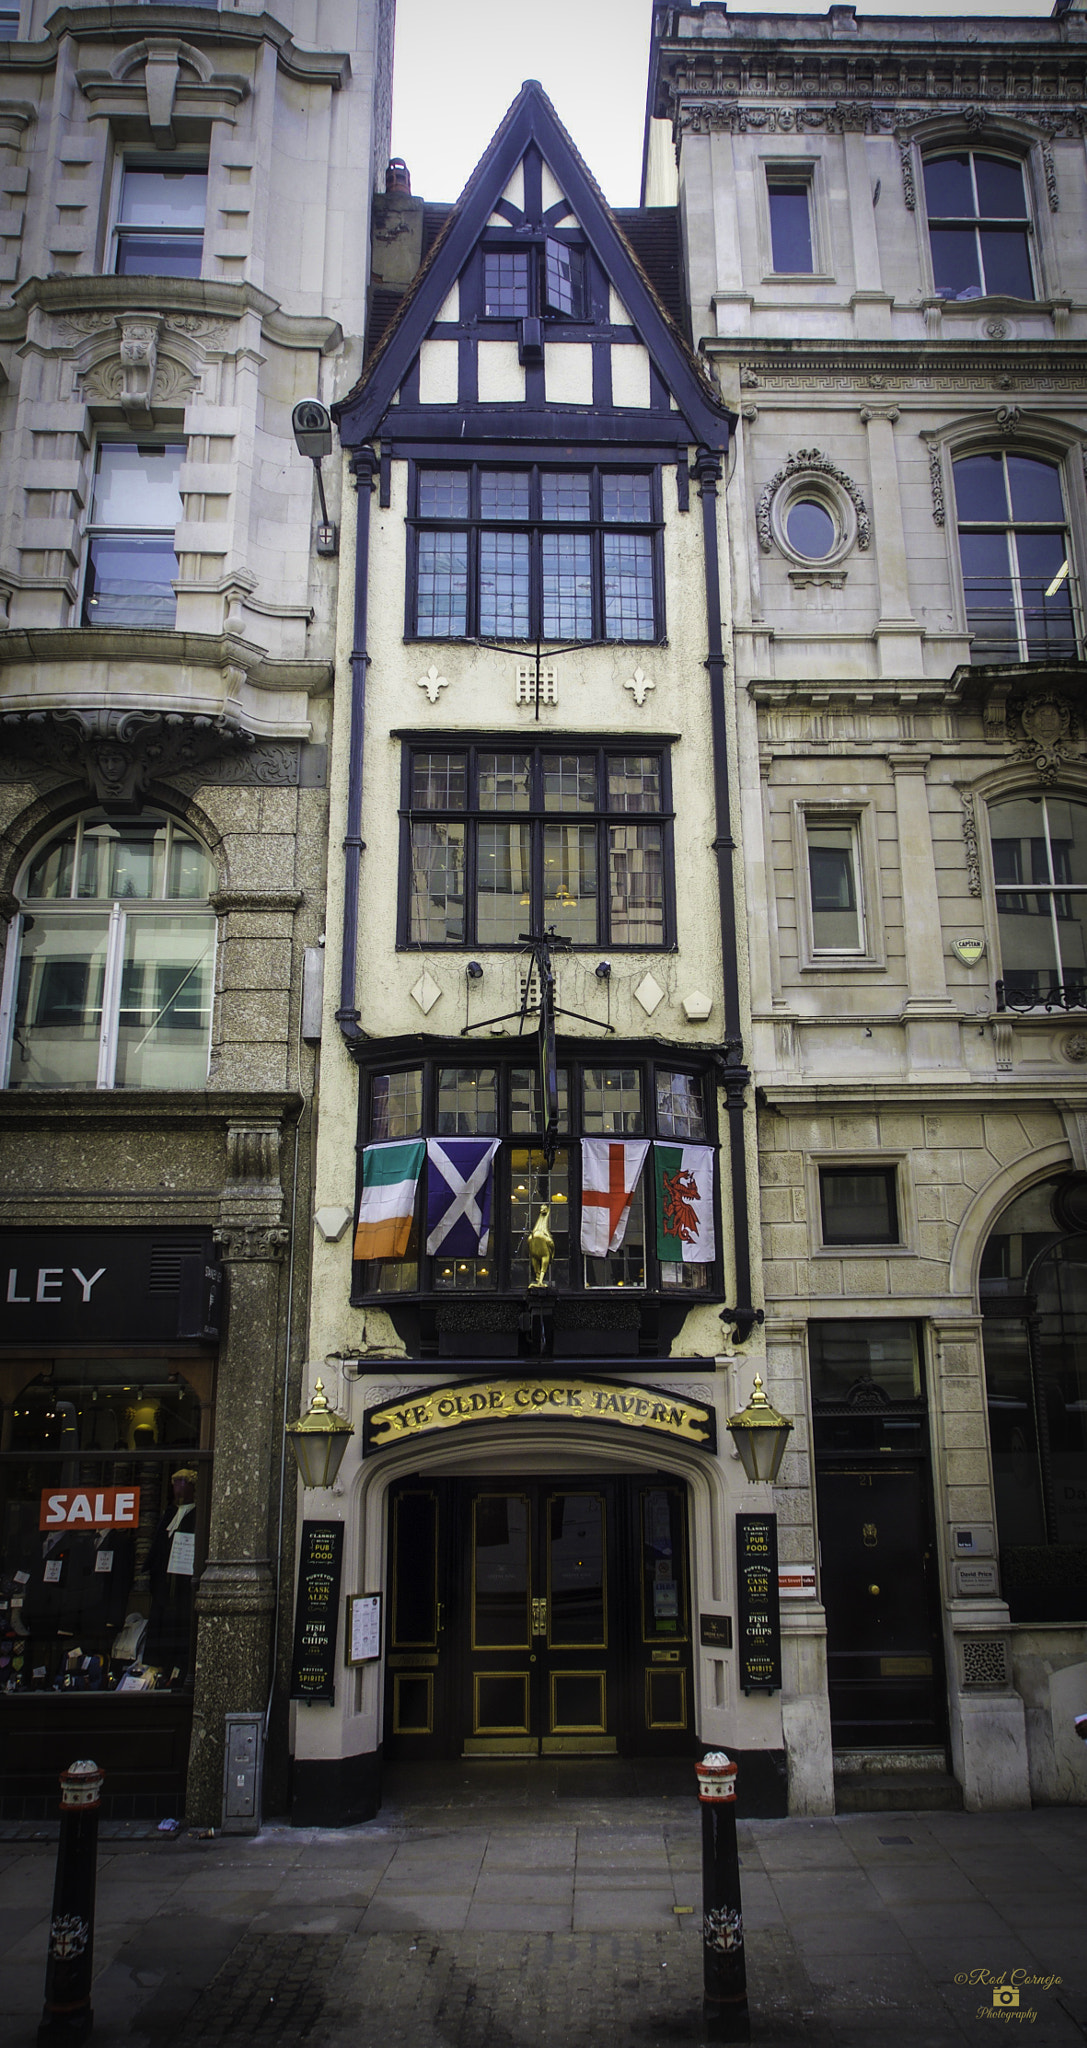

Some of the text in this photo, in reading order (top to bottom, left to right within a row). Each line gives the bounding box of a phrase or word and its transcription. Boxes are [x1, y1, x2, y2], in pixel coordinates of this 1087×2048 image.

[6, 1267, 107, 1302] LEY
[396, 1388, 687, 1428] YE OLDE COCK TAVERN
[46, 1493, 135, 1523] SALE
[310, 1552, 333, 1560] FOOD
[743, 1565, 772, 1574] PURVEYOR
[306, 1573, 334, 1582] PURVEYOR
[748, 1615, 768, 1623] FISH
[305, 1624, 326, 1632] FISH
[746, 1628, 772, 1636] CHIPS
[302, 1637, 329, 1645] CHIPS
[747, 1665, 773, 1673] SPIRITS
[299, 1674, 325, 1683] SPIRITS
